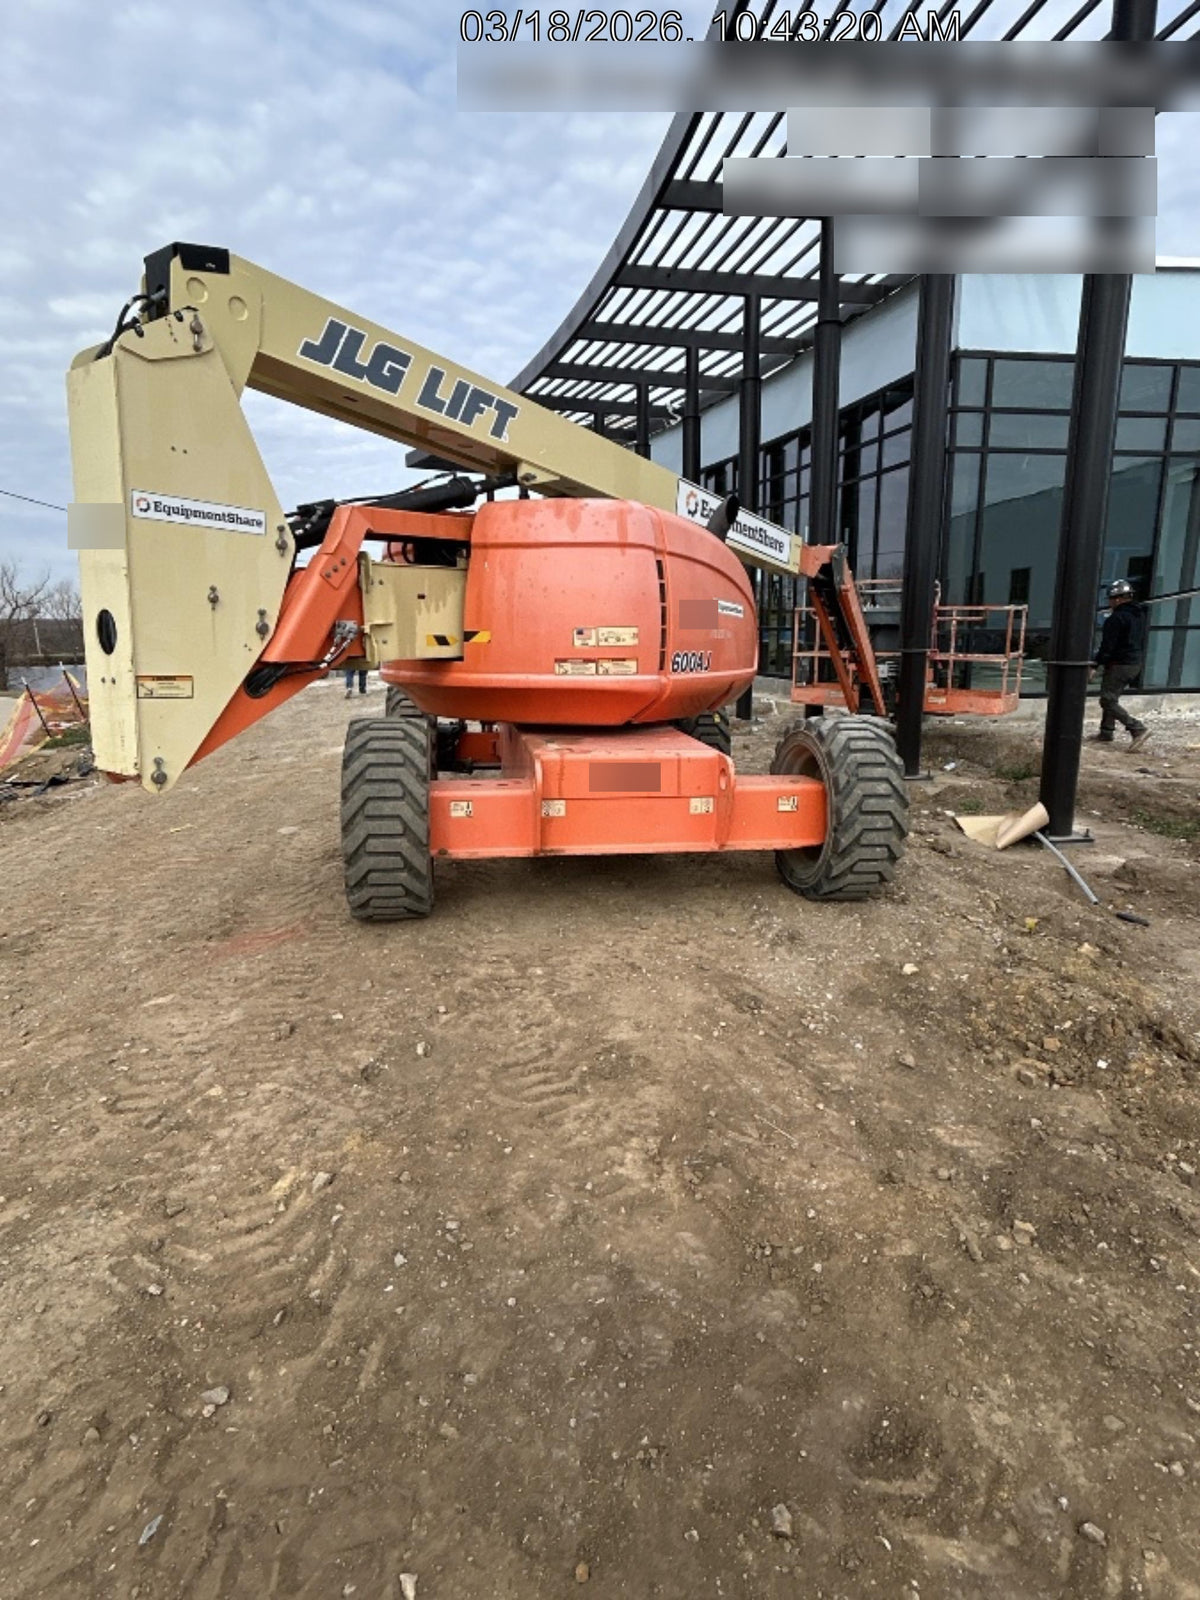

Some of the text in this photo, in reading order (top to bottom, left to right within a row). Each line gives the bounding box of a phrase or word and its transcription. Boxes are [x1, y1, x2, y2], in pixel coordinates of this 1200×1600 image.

[297, 316, 520, 442] JLG LIFT
[153, 500, 263, 528] EquipmentShare
[700, 499, 785, 554] EmentShare
